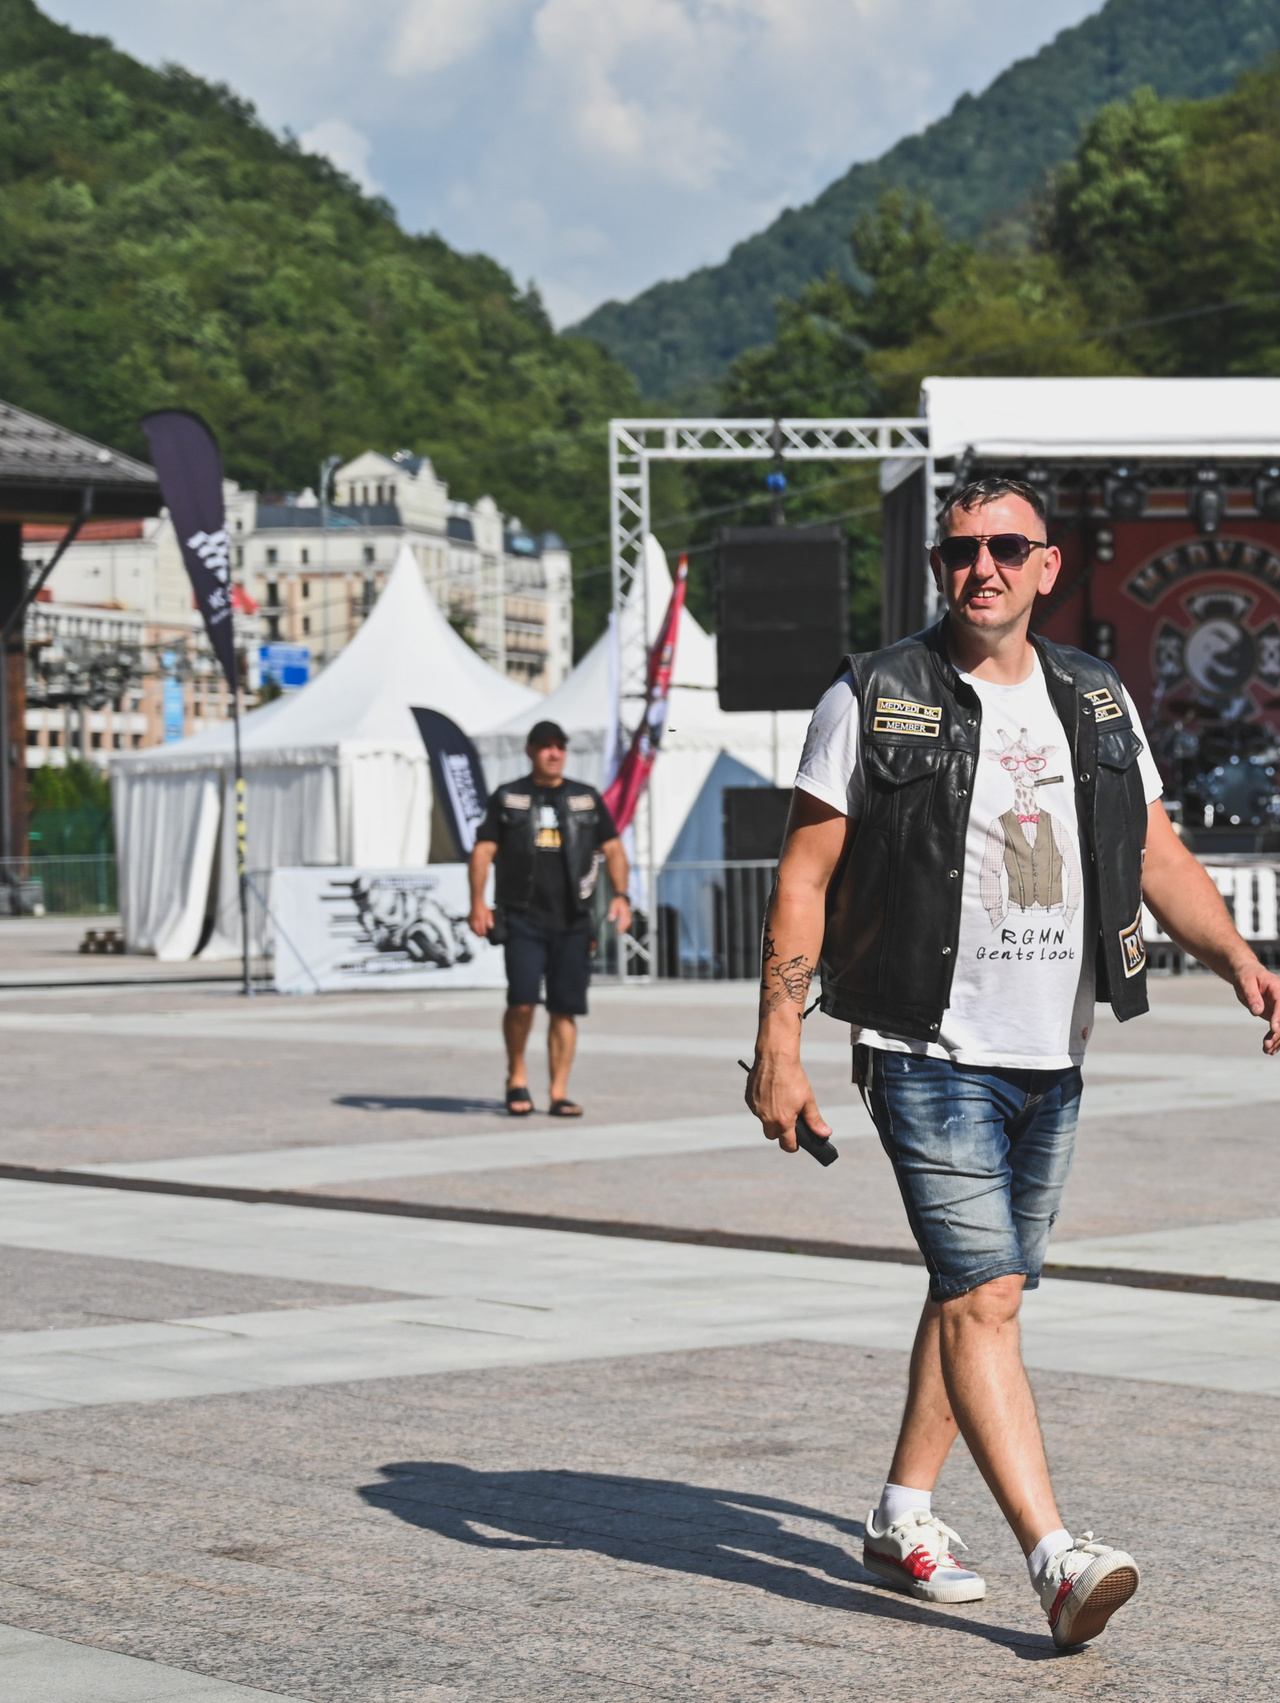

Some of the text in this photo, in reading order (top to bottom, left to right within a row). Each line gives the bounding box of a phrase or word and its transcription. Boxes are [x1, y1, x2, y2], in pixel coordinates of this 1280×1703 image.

[880, 701, 939, 717] MEDVEDI MC
[886, 721, 926, 732] MEMBER
[1001, 927, 1065, 945] RGMN
[976, 946, 1034, 961] Gents
